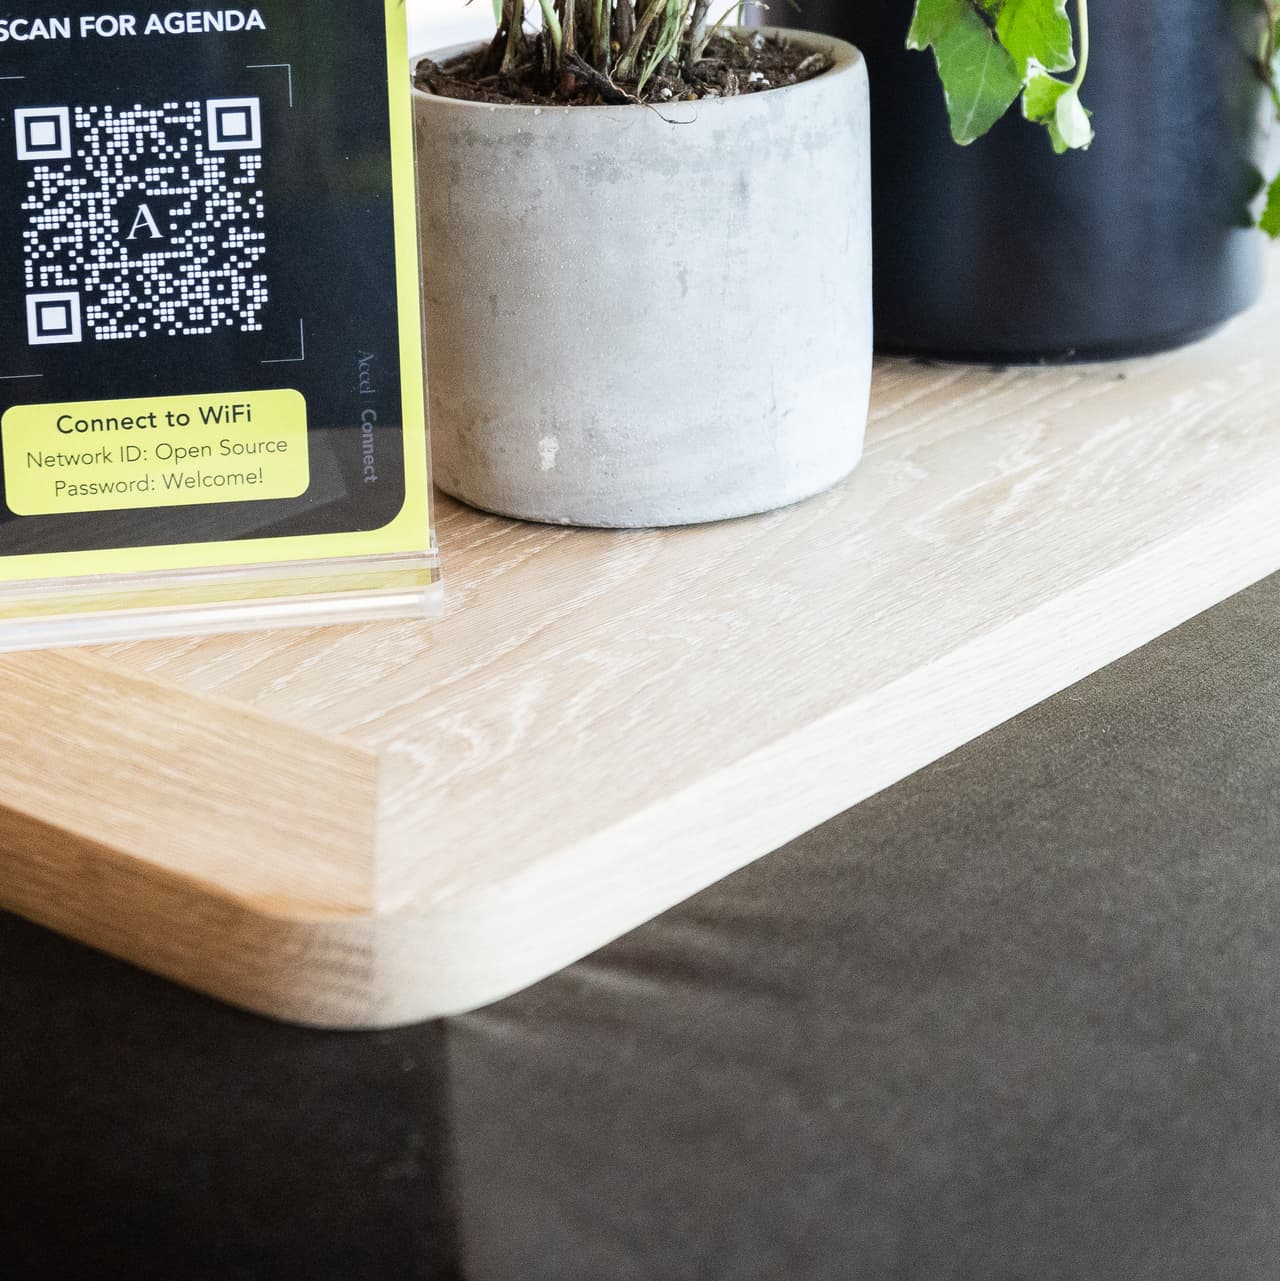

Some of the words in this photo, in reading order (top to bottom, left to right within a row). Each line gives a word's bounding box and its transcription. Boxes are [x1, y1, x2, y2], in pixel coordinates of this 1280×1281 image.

[80, 14, 136, 37] FOR
[143, 9, 266, 35] AGENDA
[125, 203, 165, 240] A
[358, 349, 376, 394] Accel
[56, 412, 157, 435] Connect
[165, 411, 191, 428] to
[198, 404, 252, 426] WiFi
[26, 446, 113, 469] Network
[120, 444, 149, 463] ID:
[155, 441, 212, 465] Open
[219, 437, 288, 456] Source
[361, 408, 378, 483] Connect
[54, 475, 156, 497] Password:
[163, 468, 264, 491] Welcome!
